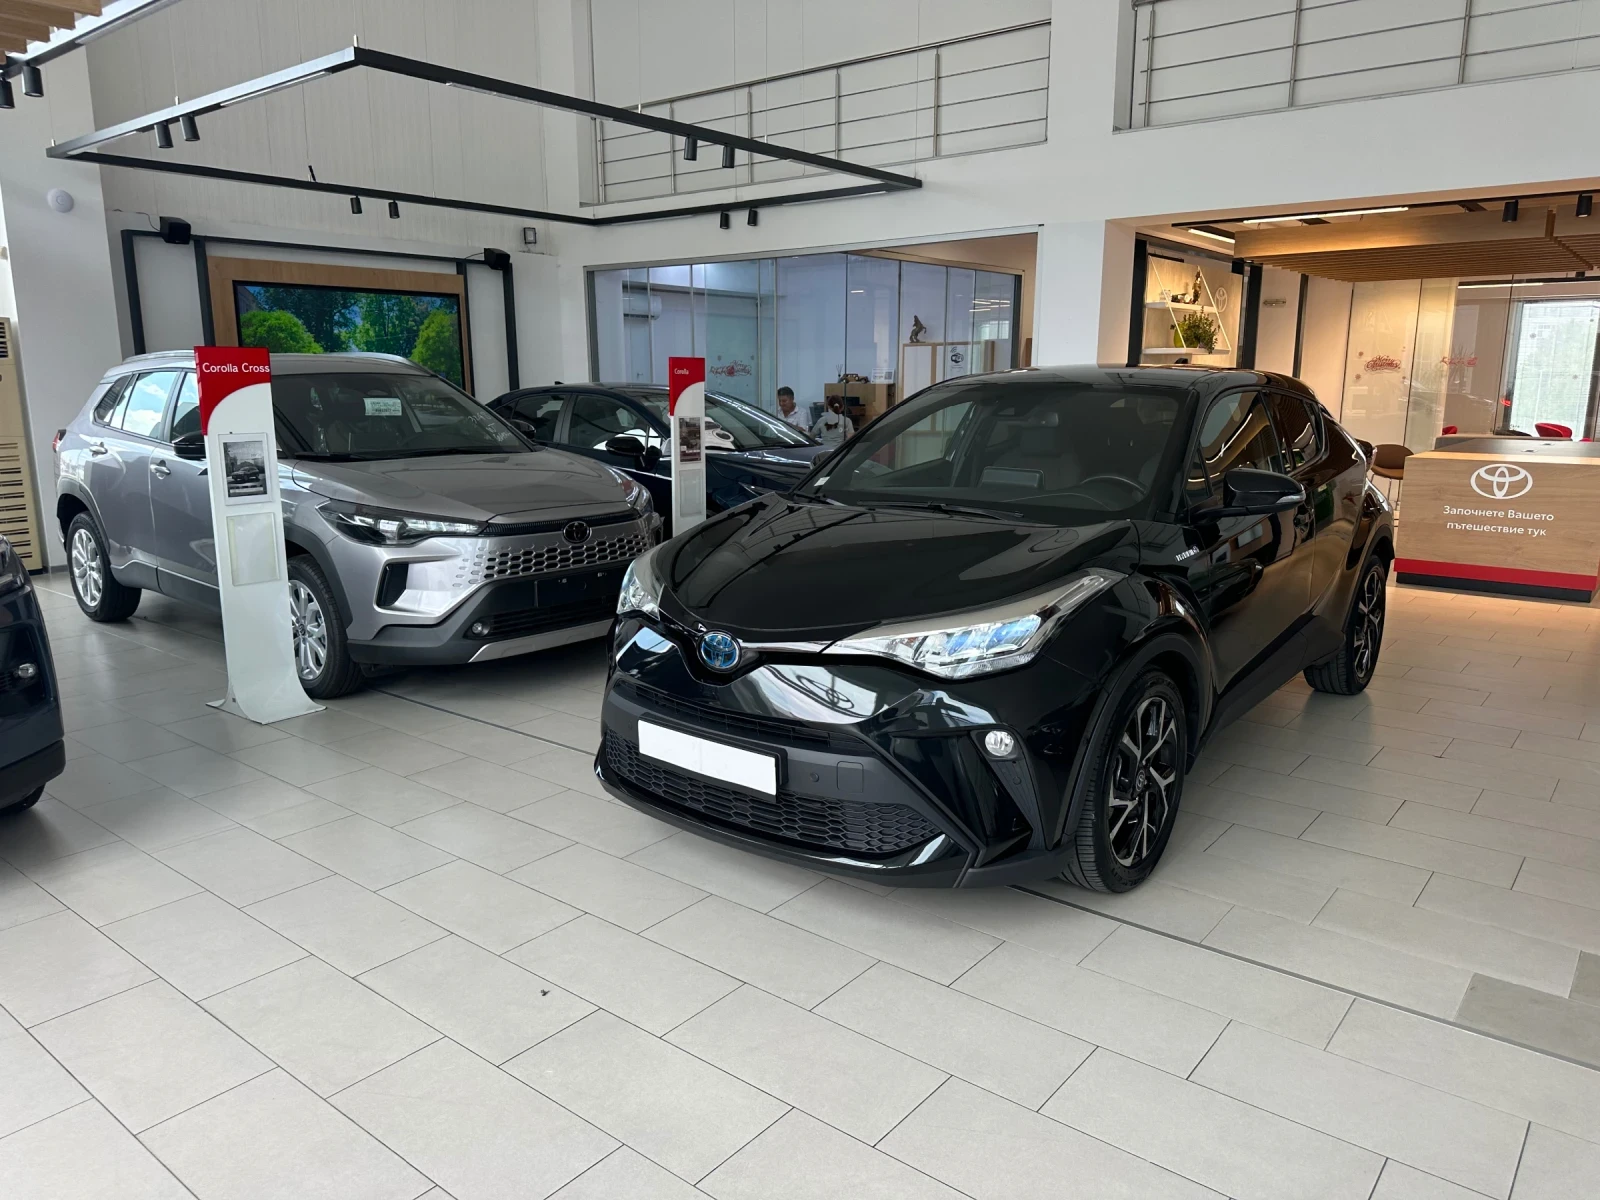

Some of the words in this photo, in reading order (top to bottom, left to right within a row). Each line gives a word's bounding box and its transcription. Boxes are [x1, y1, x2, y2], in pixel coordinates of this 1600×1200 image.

[202, 362, 239, 373] Corolla
[241, 362, 271, 373] Cross
[1442, 505, 1505, 518] Започнете
[1507, 509, 1555, 522] Вашето
[1446, 522, 1525, 535] пътешествие
[1527, 528, 1547, 538] тук
